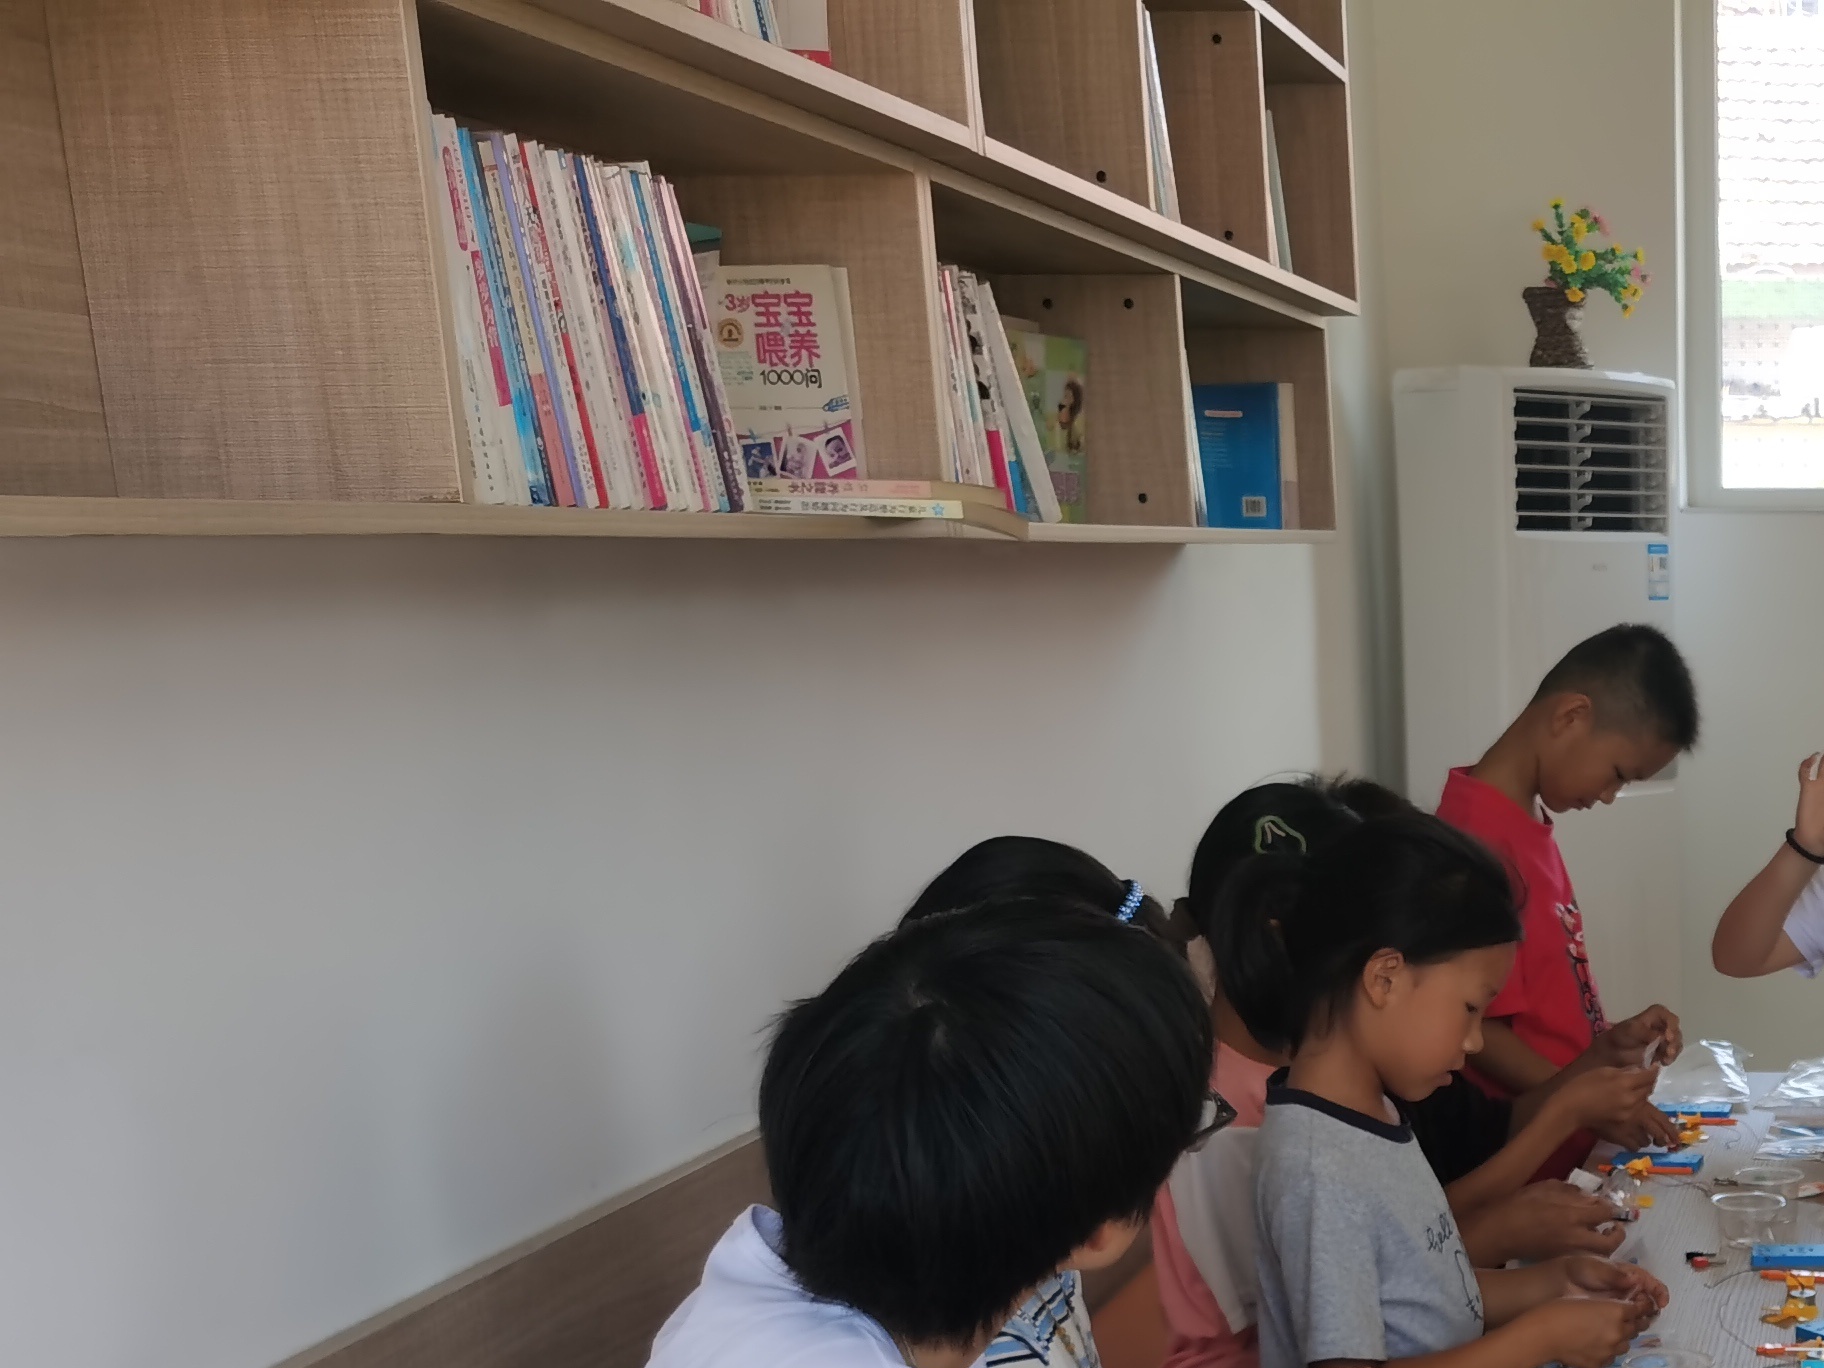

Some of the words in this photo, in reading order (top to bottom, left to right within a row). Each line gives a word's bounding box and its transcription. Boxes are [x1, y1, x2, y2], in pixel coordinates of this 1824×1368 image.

[751, 290, 816, 328] 宝宝
[755, 330, 821, 368] 喂养
[760, 369, 823, 389] 1000问
